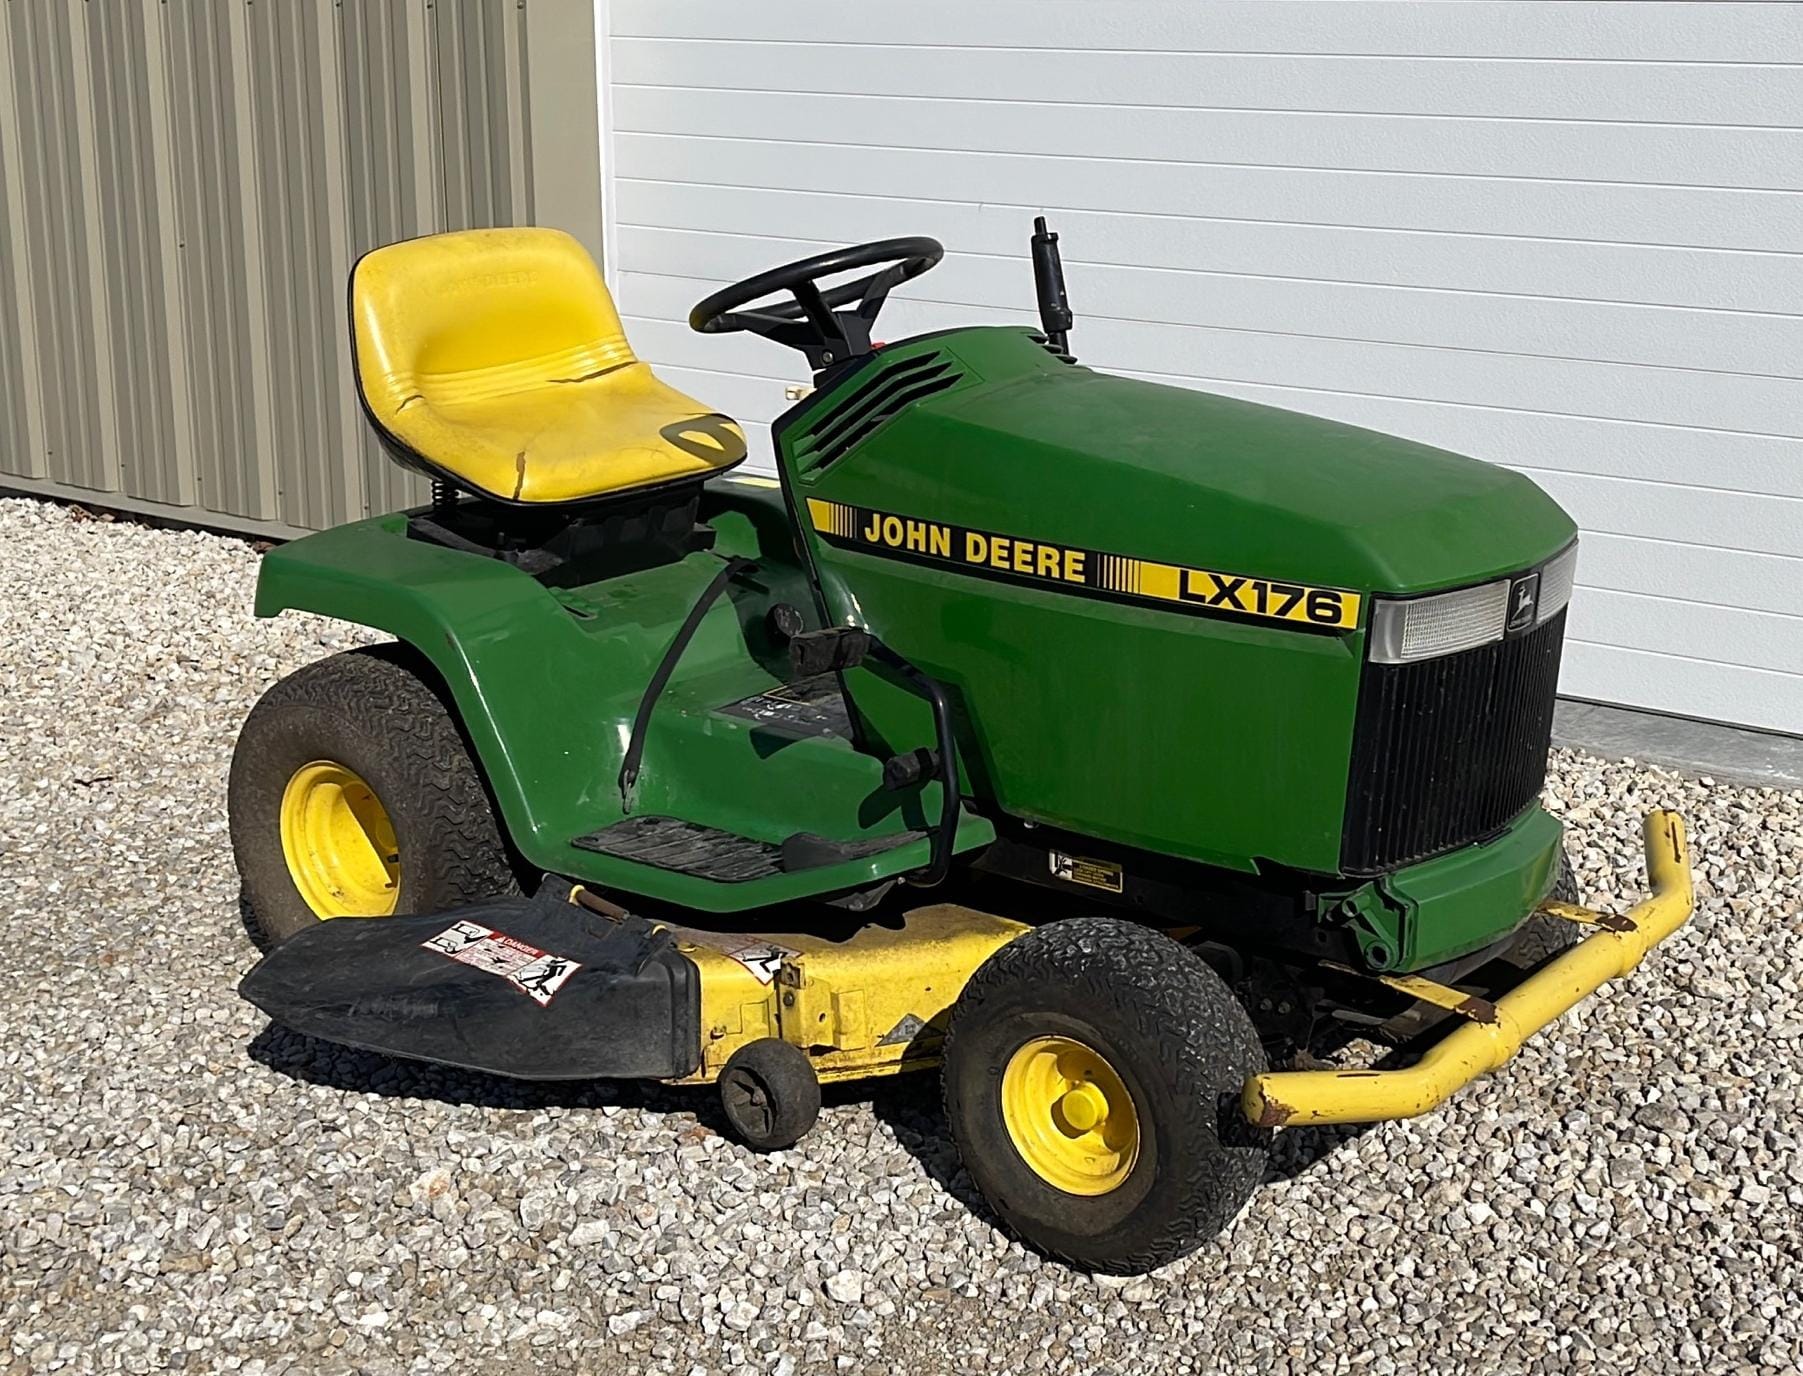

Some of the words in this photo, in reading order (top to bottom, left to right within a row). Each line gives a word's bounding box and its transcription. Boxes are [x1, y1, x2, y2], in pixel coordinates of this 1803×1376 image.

[864, 514, 951, 558] JOHN
[966, 532, 1086, 583] DEERE
[1179, 570, 1343, 625] LX176
[504, 938, 539, 955] DANGER
